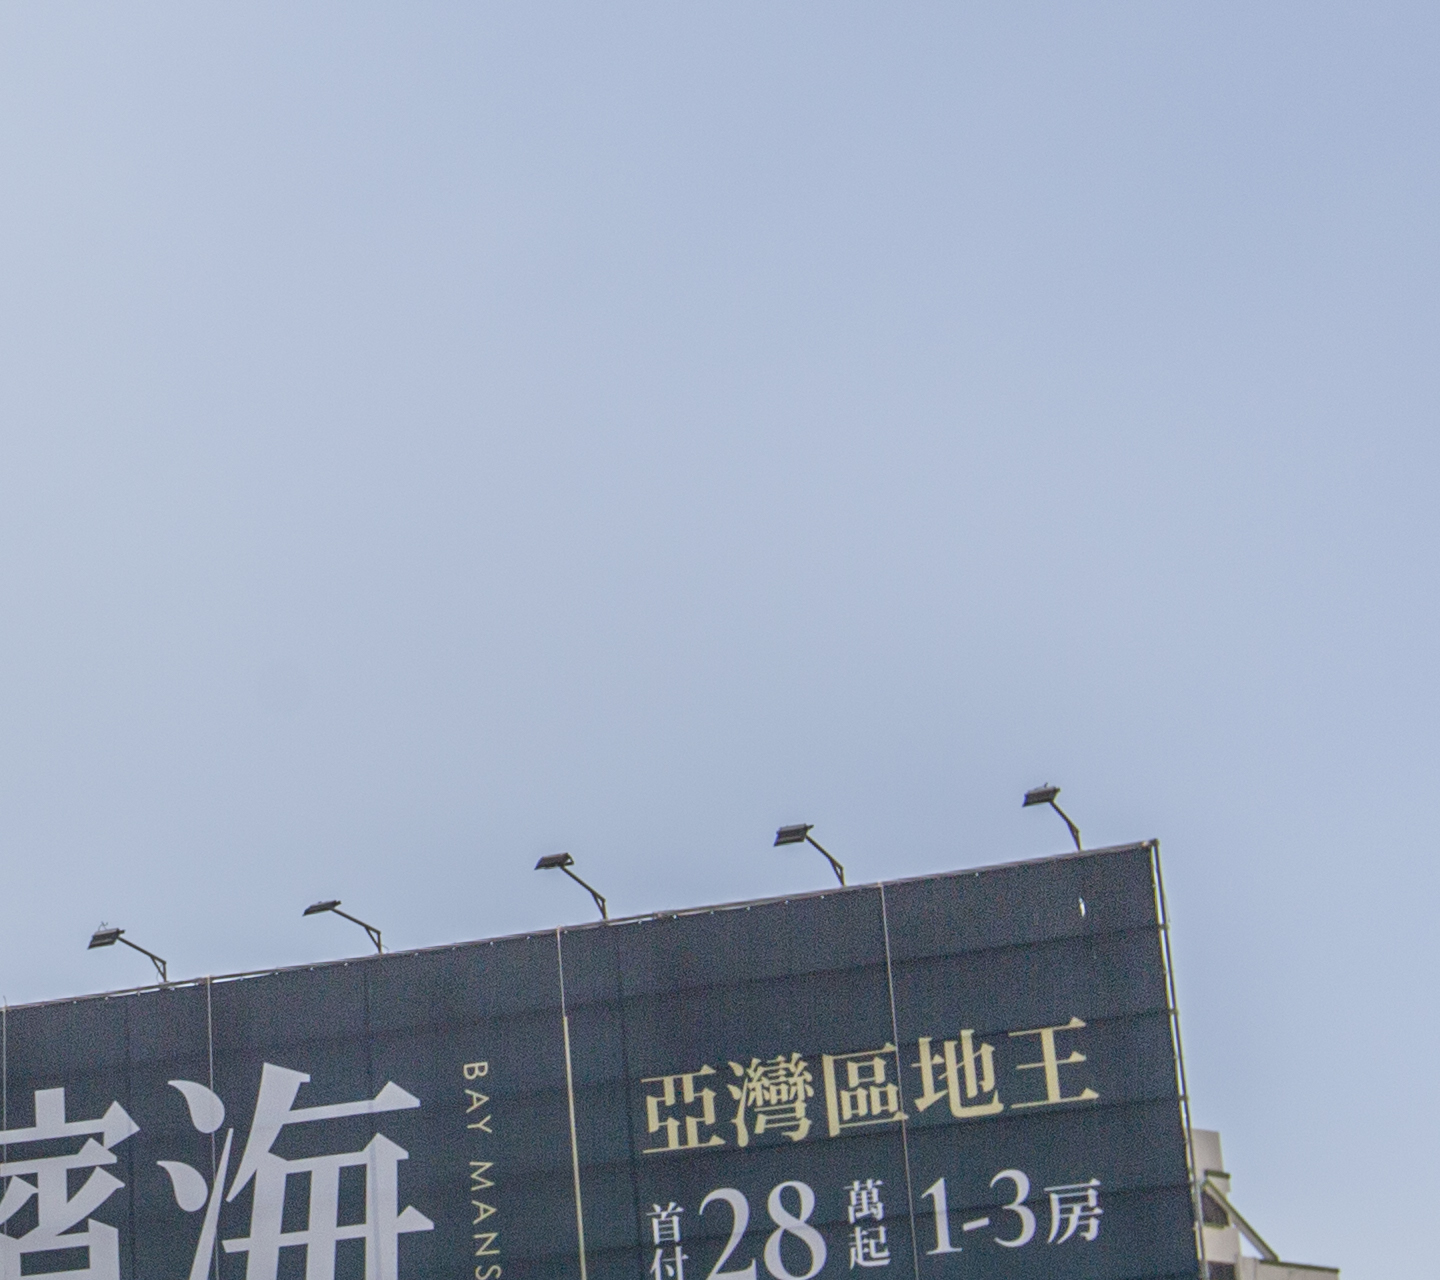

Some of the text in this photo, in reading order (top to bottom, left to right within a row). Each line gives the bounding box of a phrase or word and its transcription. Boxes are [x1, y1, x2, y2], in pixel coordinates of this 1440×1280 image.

[462, 1061, 493, 1134] BAY
[639, 1016, 1100, 1155] 亞灣區地王
[844, 1179, 892, 1271] 萬起
[920, 1168, 1105, 1257] 1-3房
